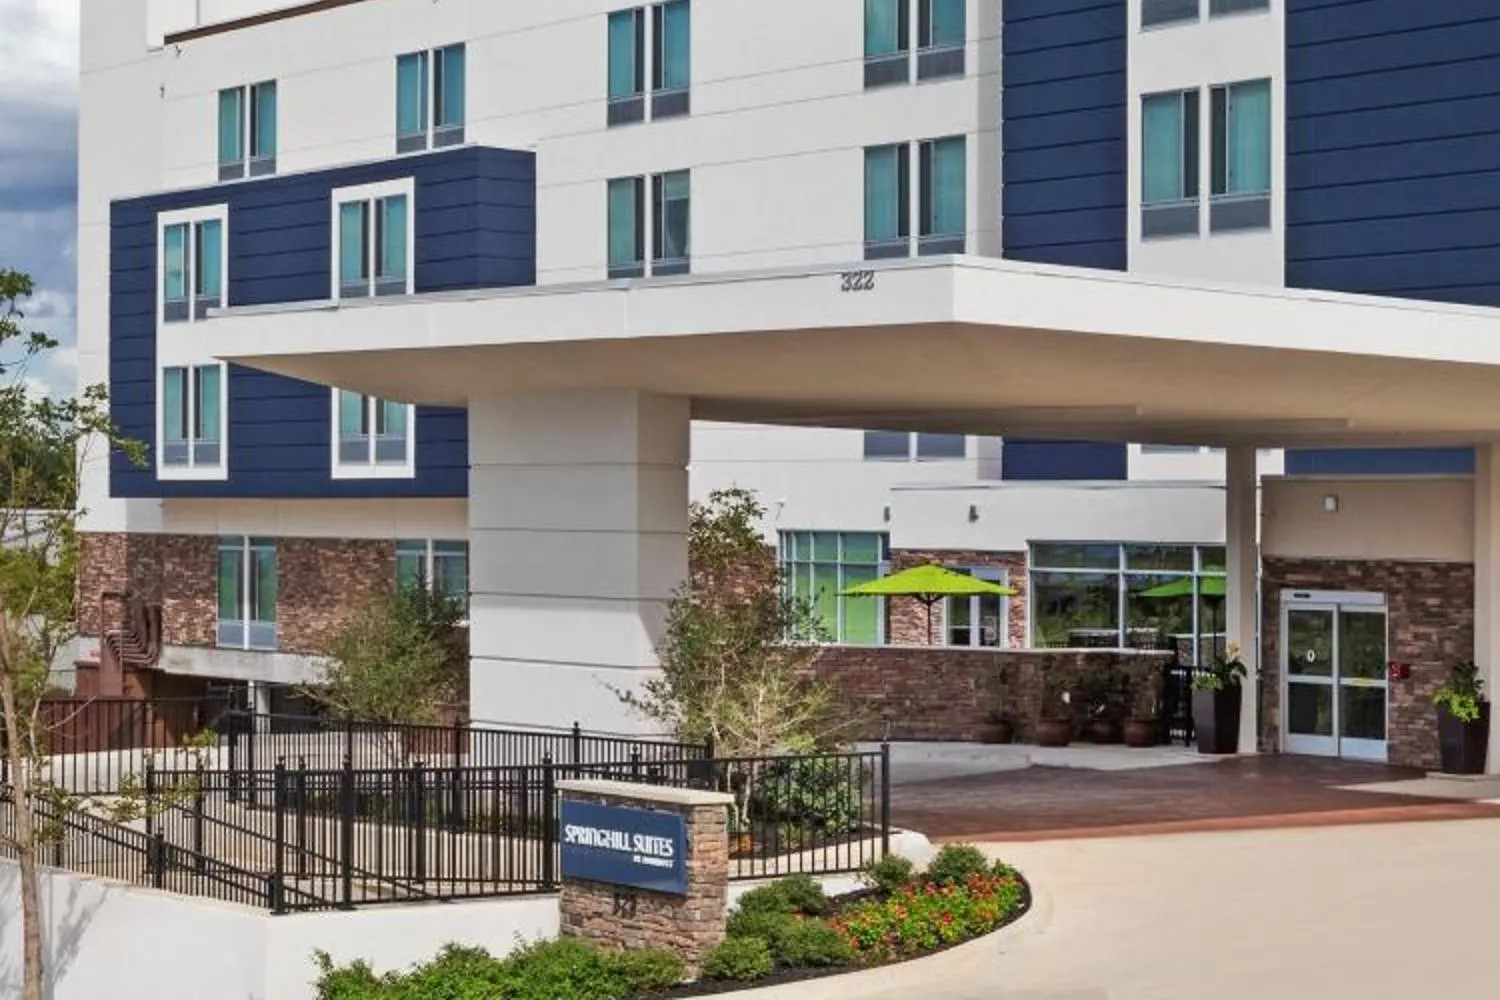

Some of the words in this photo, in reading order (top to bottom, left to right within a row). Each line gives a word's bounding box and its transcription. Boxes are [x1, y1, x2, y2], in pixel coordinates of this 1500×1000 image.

[841, 270, 876, 292] 322
[564, 824, 632, 852] SPRINGHILL
[633, 834, 674, 857] SUITES
